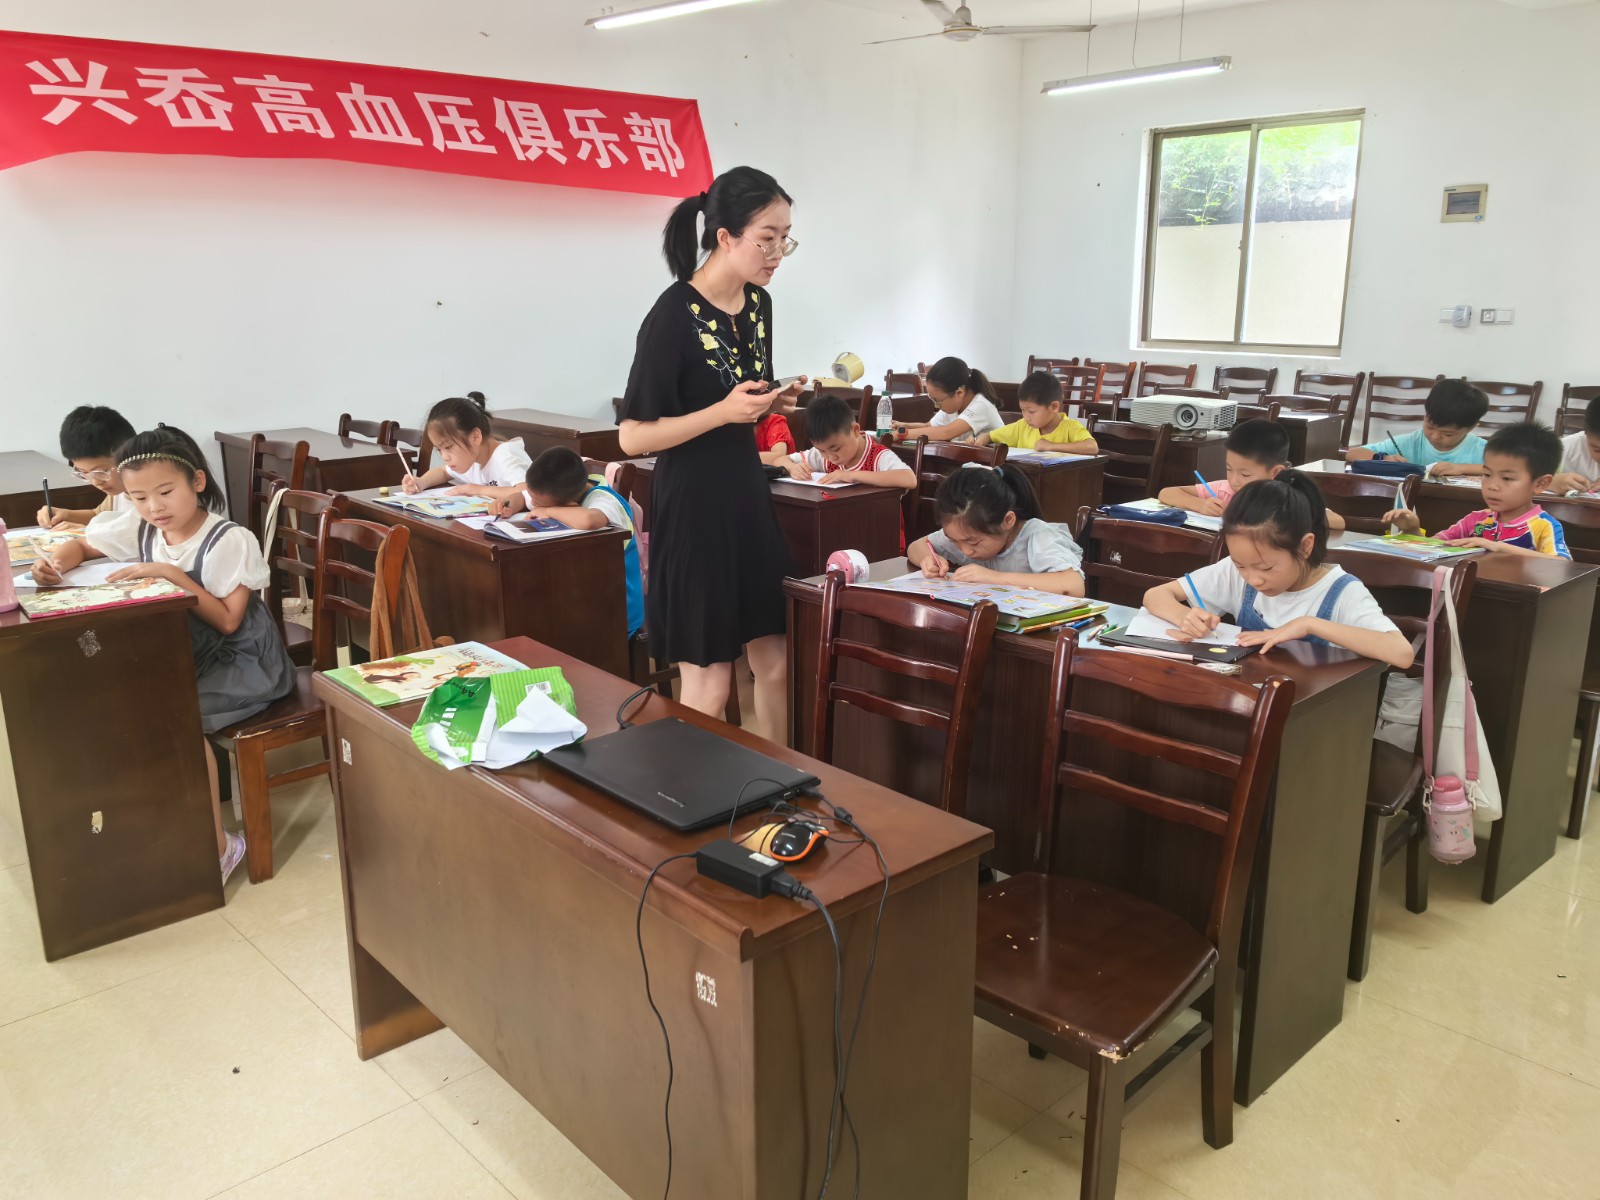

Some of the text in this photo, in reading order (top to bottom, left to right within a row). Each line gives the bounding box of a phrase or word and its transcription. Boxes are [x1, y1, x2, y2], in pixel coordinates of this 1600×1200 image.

[25, 57, 685, 178] 兴岙高血压俱乐部
